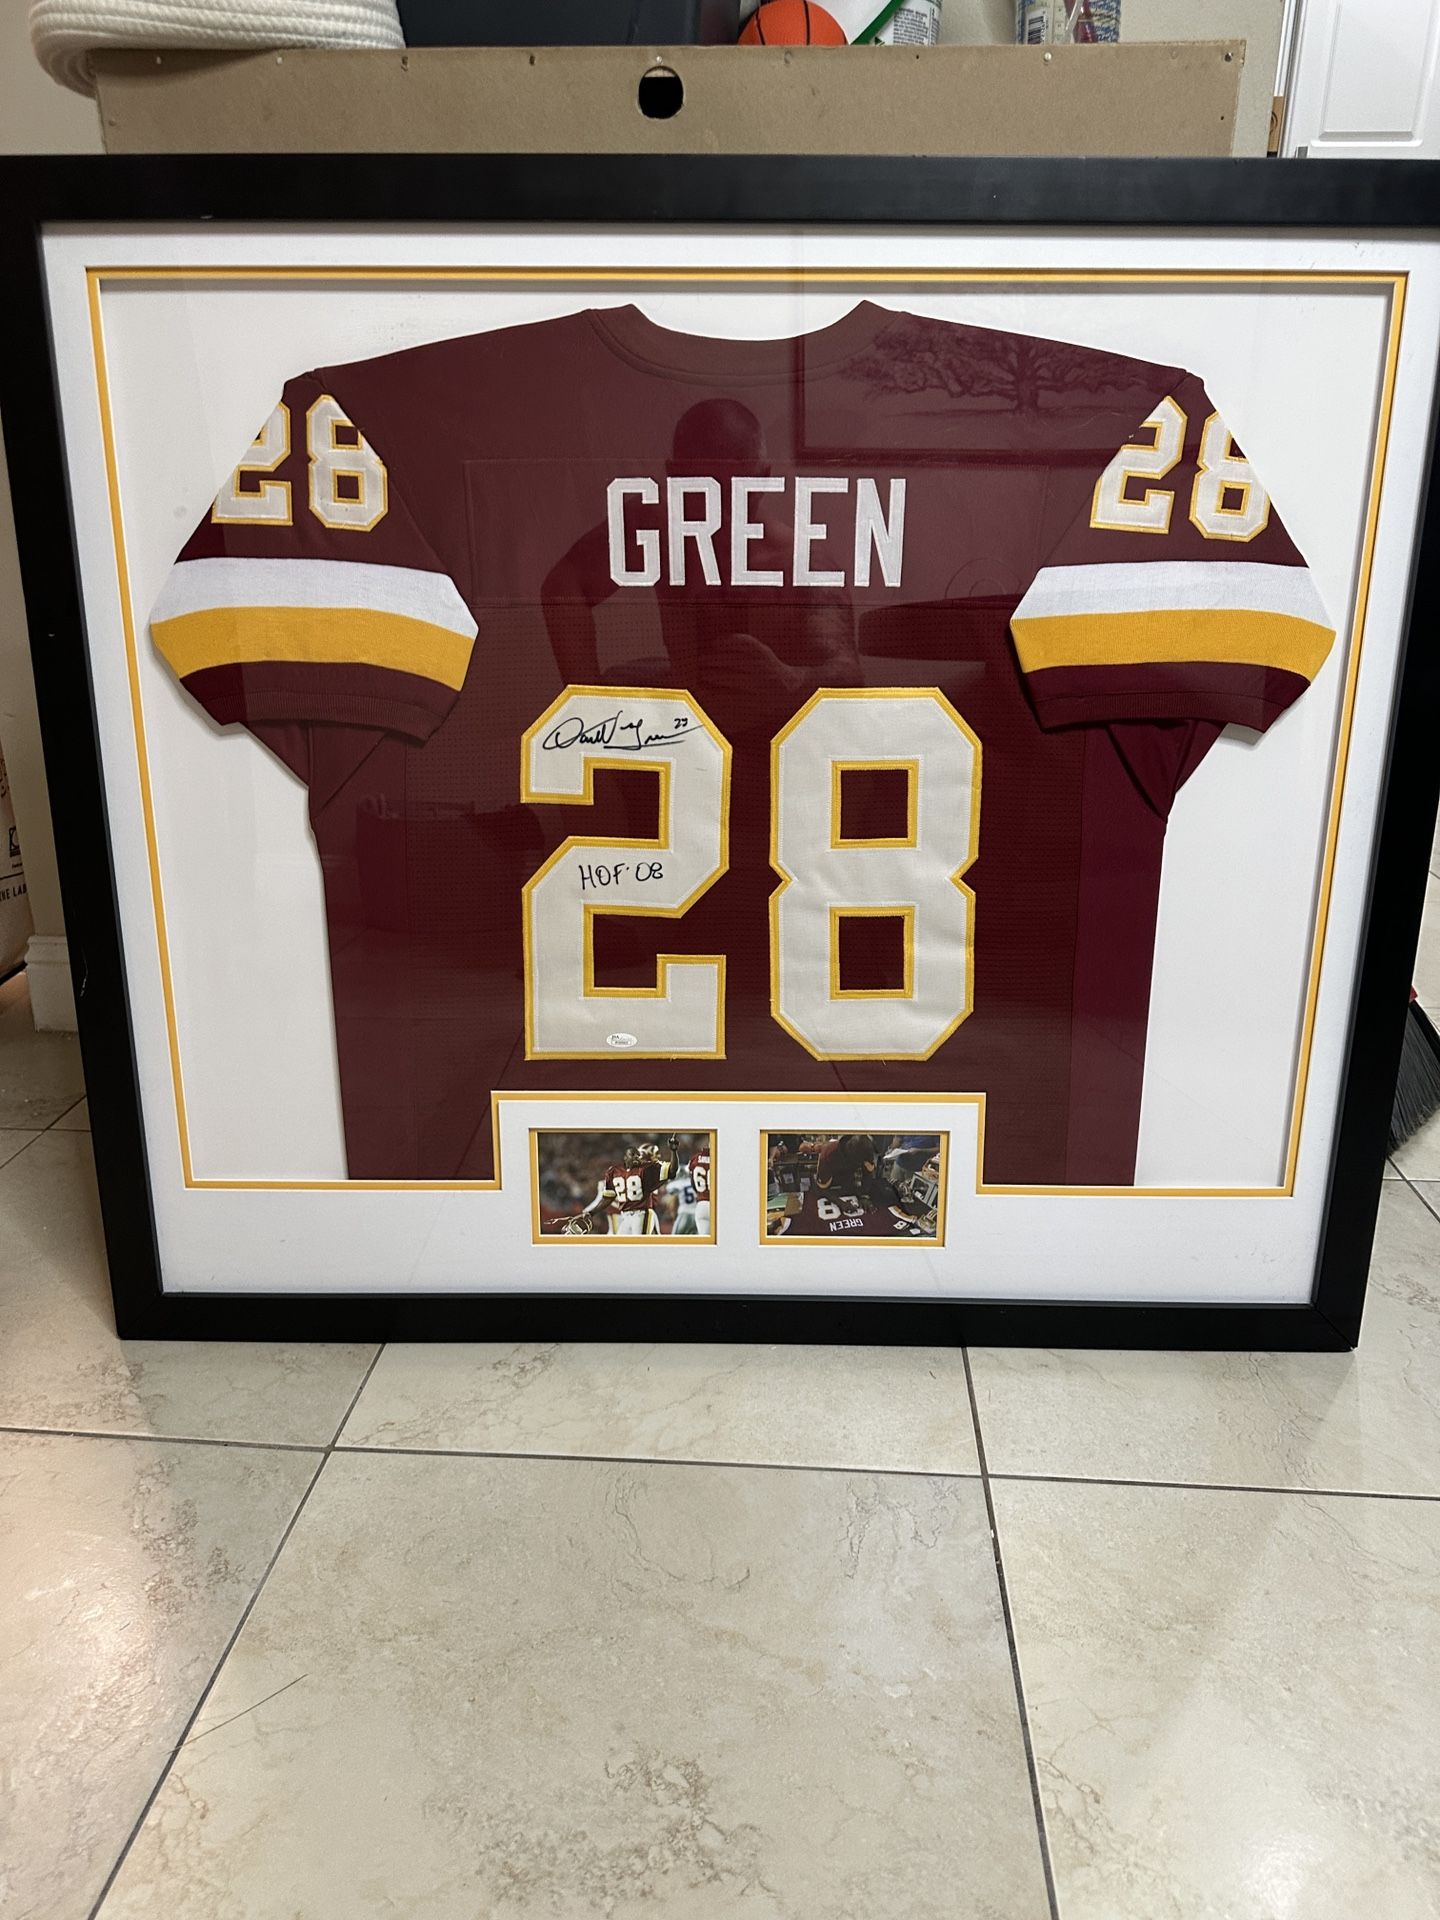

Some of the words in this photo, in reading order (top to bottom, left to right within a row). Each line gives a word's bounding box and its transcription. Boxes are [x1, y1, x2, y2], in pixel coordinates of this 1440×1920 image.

[211, 394, 388, 532] 28
[1090, 395, 1271, 543] 28
[607, 476, 906, 587] GREEN
[520, 684, 982, 1061] 28
[613, 1175, 644, 1202] 28
[692, 1166, 710, 1193] 6
[829, 1218, 864, 1232] GREEN
